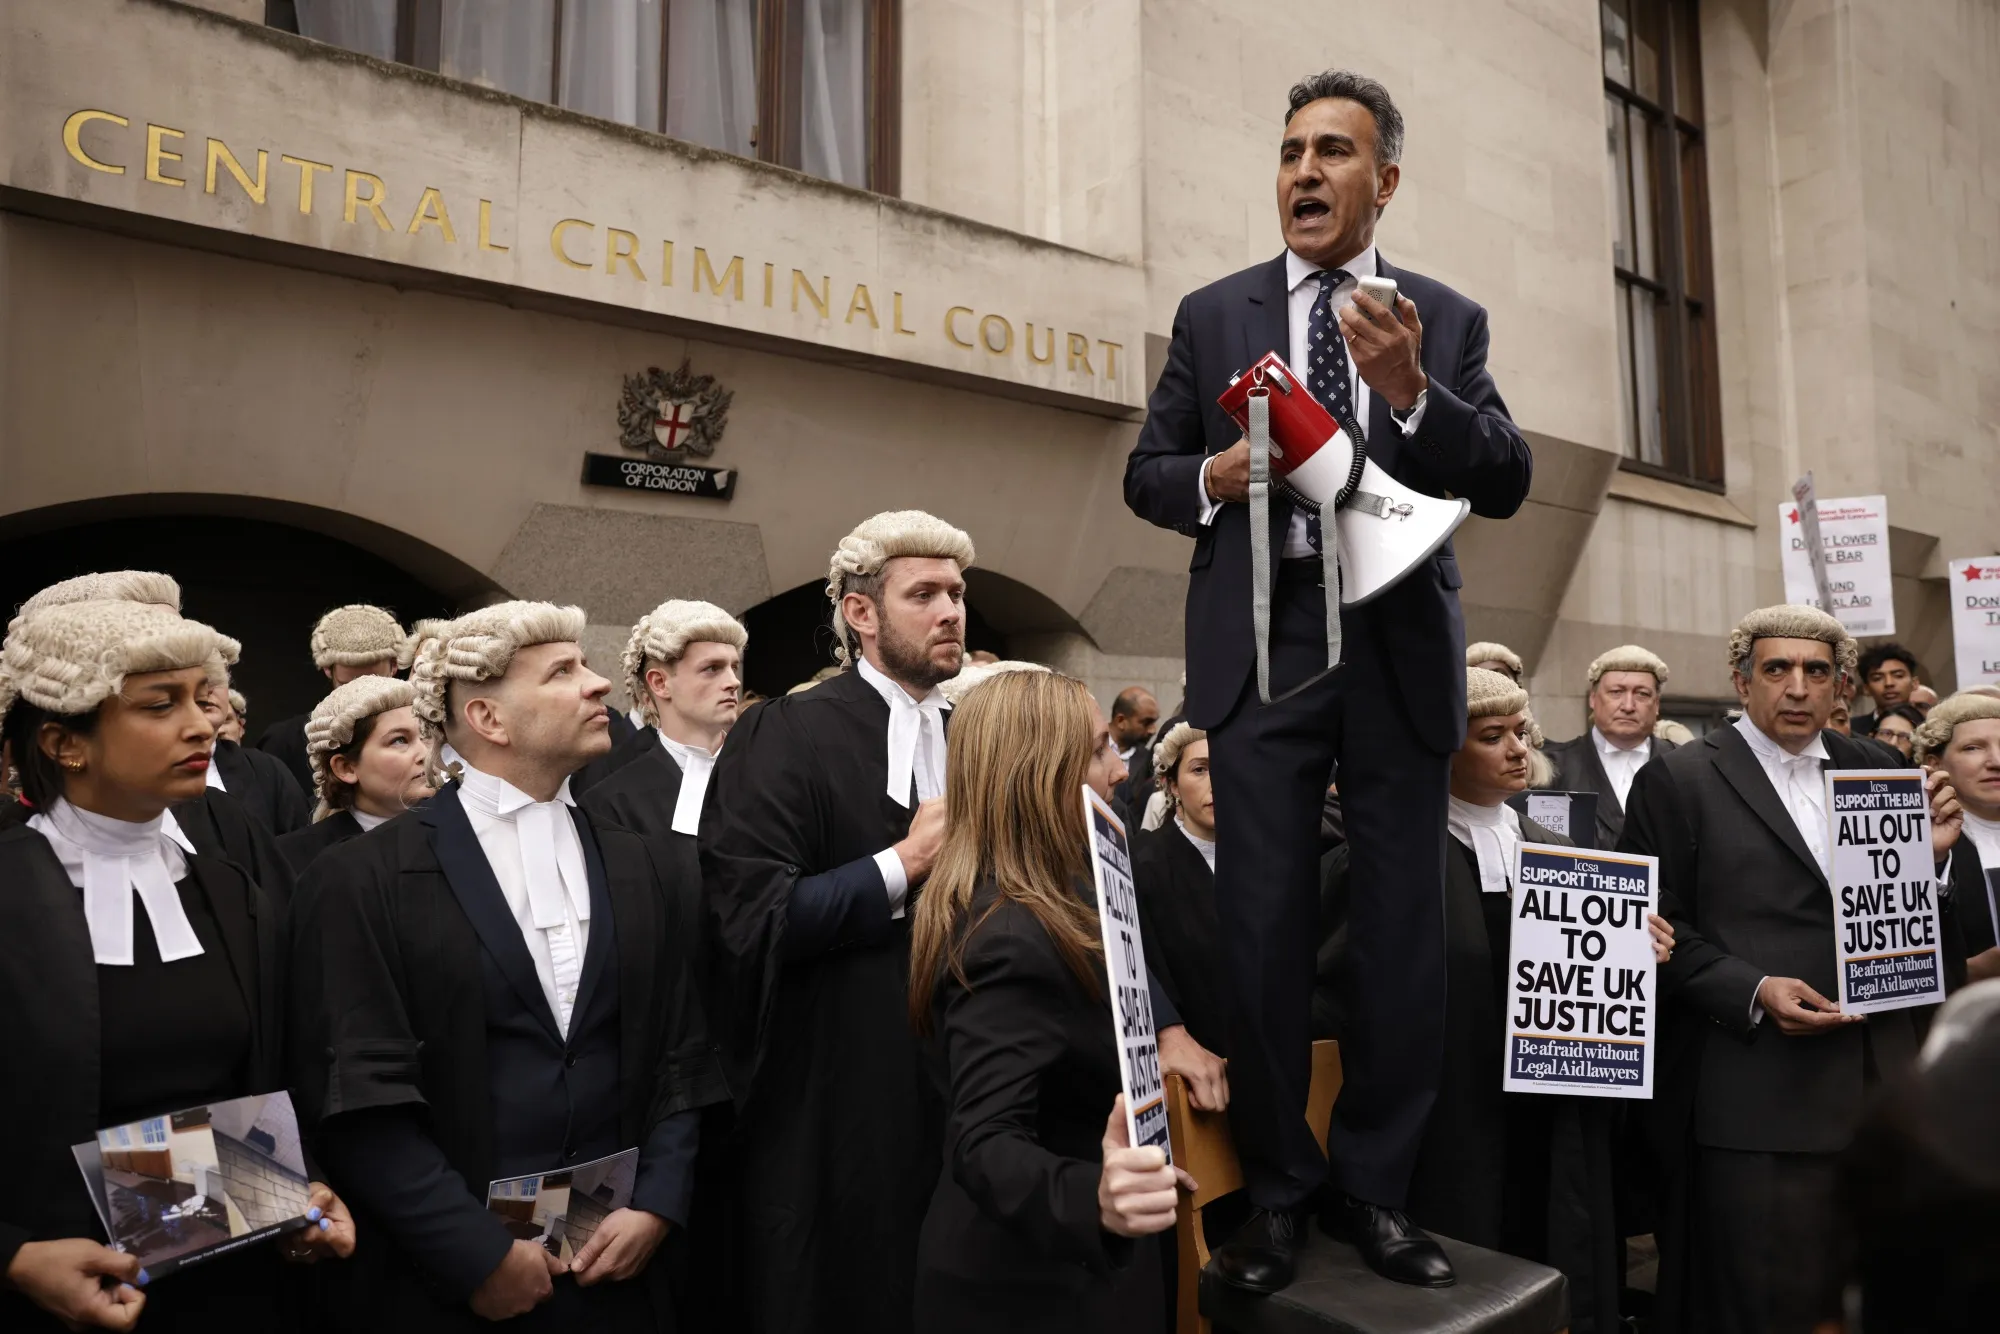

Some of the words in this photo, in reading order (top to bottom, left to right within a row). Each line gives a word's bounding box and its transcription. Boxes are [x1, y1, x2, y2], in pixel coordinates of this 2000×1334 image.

[61, 108, 511, 254] CENTRAL
[549, 217, 917, 337] CRIMINAL
[943, 304, 1124, 380] COURT
[620, 461, 706, 482] CORPORATION
[625, 474, 643, 487] OF
[645, 476, 698, 492] LONDON
[1832, 533, 1877, 546] LOWER
[1836, 550, 1864, 562] BAR
[1828, 581, 1856, 592] UND
[1850, 595, 1872, 605] AID
[1835, 793, 1882, 809] SUPPORT
[1882, 793, 1902, 807] THE
[1903, 793, 1922, 807] BAR
[1533, 815, 1551, 824] OUT
[1553, 815, 1564, 824] OF
[1541, 824, 1564, 832] RDER
[1837, 815, 1878, 846] ALL
[1879, 813, 1925, 844] OUT
[1868, 848, 1900, 879] TO
[1521, 866, 1588, 889] SUPPORT
[1592, 873, 1617, 890] THE
[1618, 877, 1646, 894] BAR
[1519, 888, 1577, 923] ALL
[1581, 894, 1649, 930] OUT
[1841, 882, 1896, 918] SAVE
[1902, 880, 1932, 912] UK
[1561, 927, 1607, 961] TO
[1843, 915, 1935, 954] JUSTICE
[1120, 929, 1137, 981] TO
[1849, 963, 1864, 979] Be
[1864, 957, 1896, 977] afraid
[1895, 955, 1933, 972] without
[1515, 959, 1594, 997] SAVE
[1603, 967, 1647, 1001] UK
[1849, 978, 1879, 999] Legal
[1880, 975, 1899, 993] Aid
[1899, 974, 1935, 993] lawyers
[1118, 984, 1144, 1038] SAVE
[1513, 996, 1646, 1037] JUSTICE
[1518, 1038, 1538, 1055] Be
[1539, 1040, 1583, 1058] afraid
[1583, 1042, 1639, 1062] without
[1126, 1043, 1161, 1101] JUSTICE
[1516, 1058, 1557, 1080] Legal
[1558, 1059, 1586, 1077] Aid
[1586, 1061, 1639, 1082] lawyers
